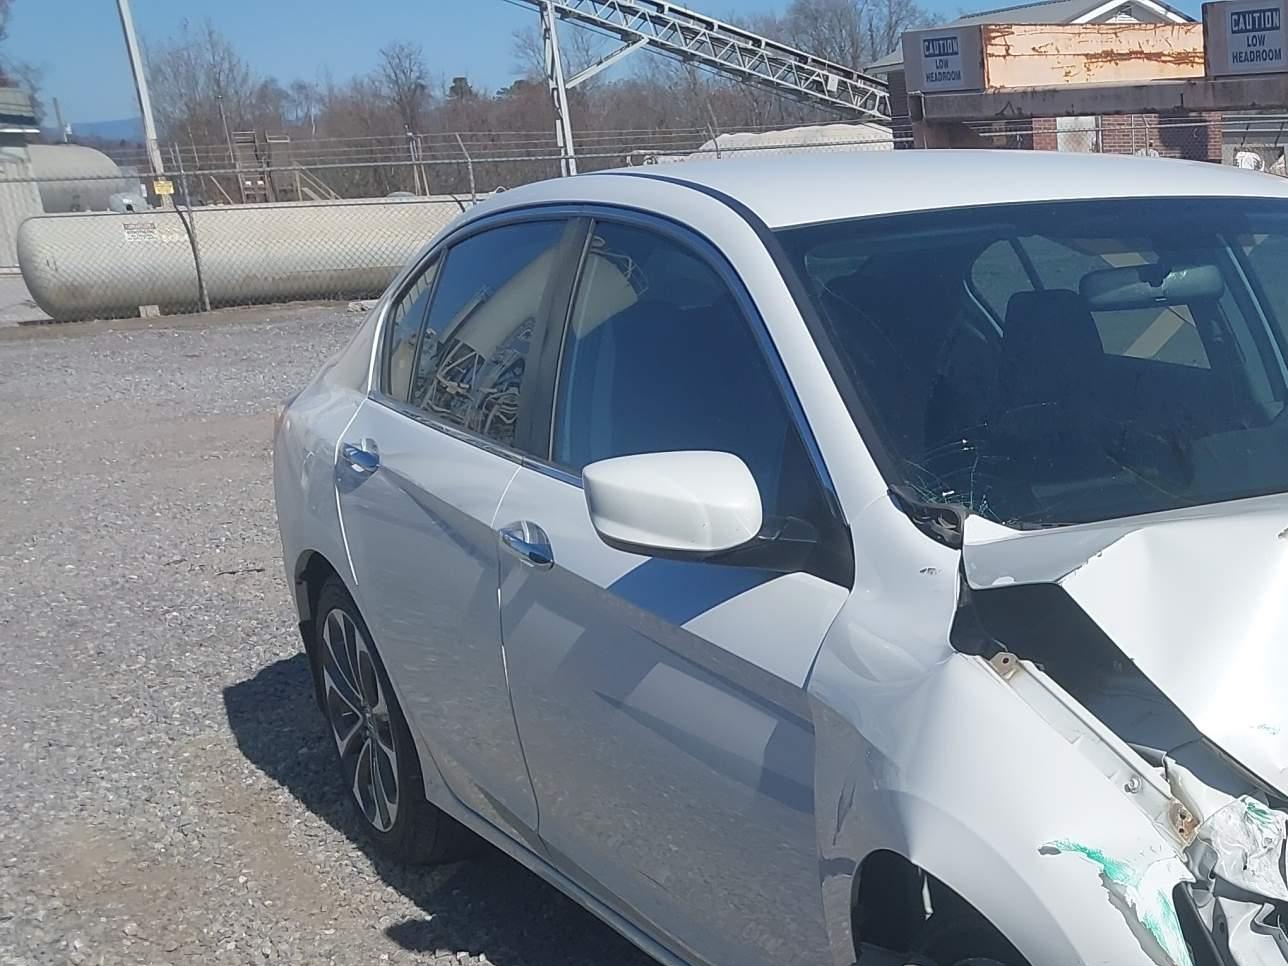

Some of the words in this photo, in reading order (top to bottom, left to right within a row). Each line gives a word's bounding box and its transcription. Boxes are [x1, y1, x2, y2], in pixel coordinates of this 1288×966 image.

[1232, 11, 1280, 31] CAUTION
[924, 39, 959, 55] CAUTION
[1246, 34, 1266, 48] LOW
[936, 58, 949, 69] LOW
[1232, 48, 1282, 64] HEADROOM
[926, 70, 961, 82] HEADROOM
